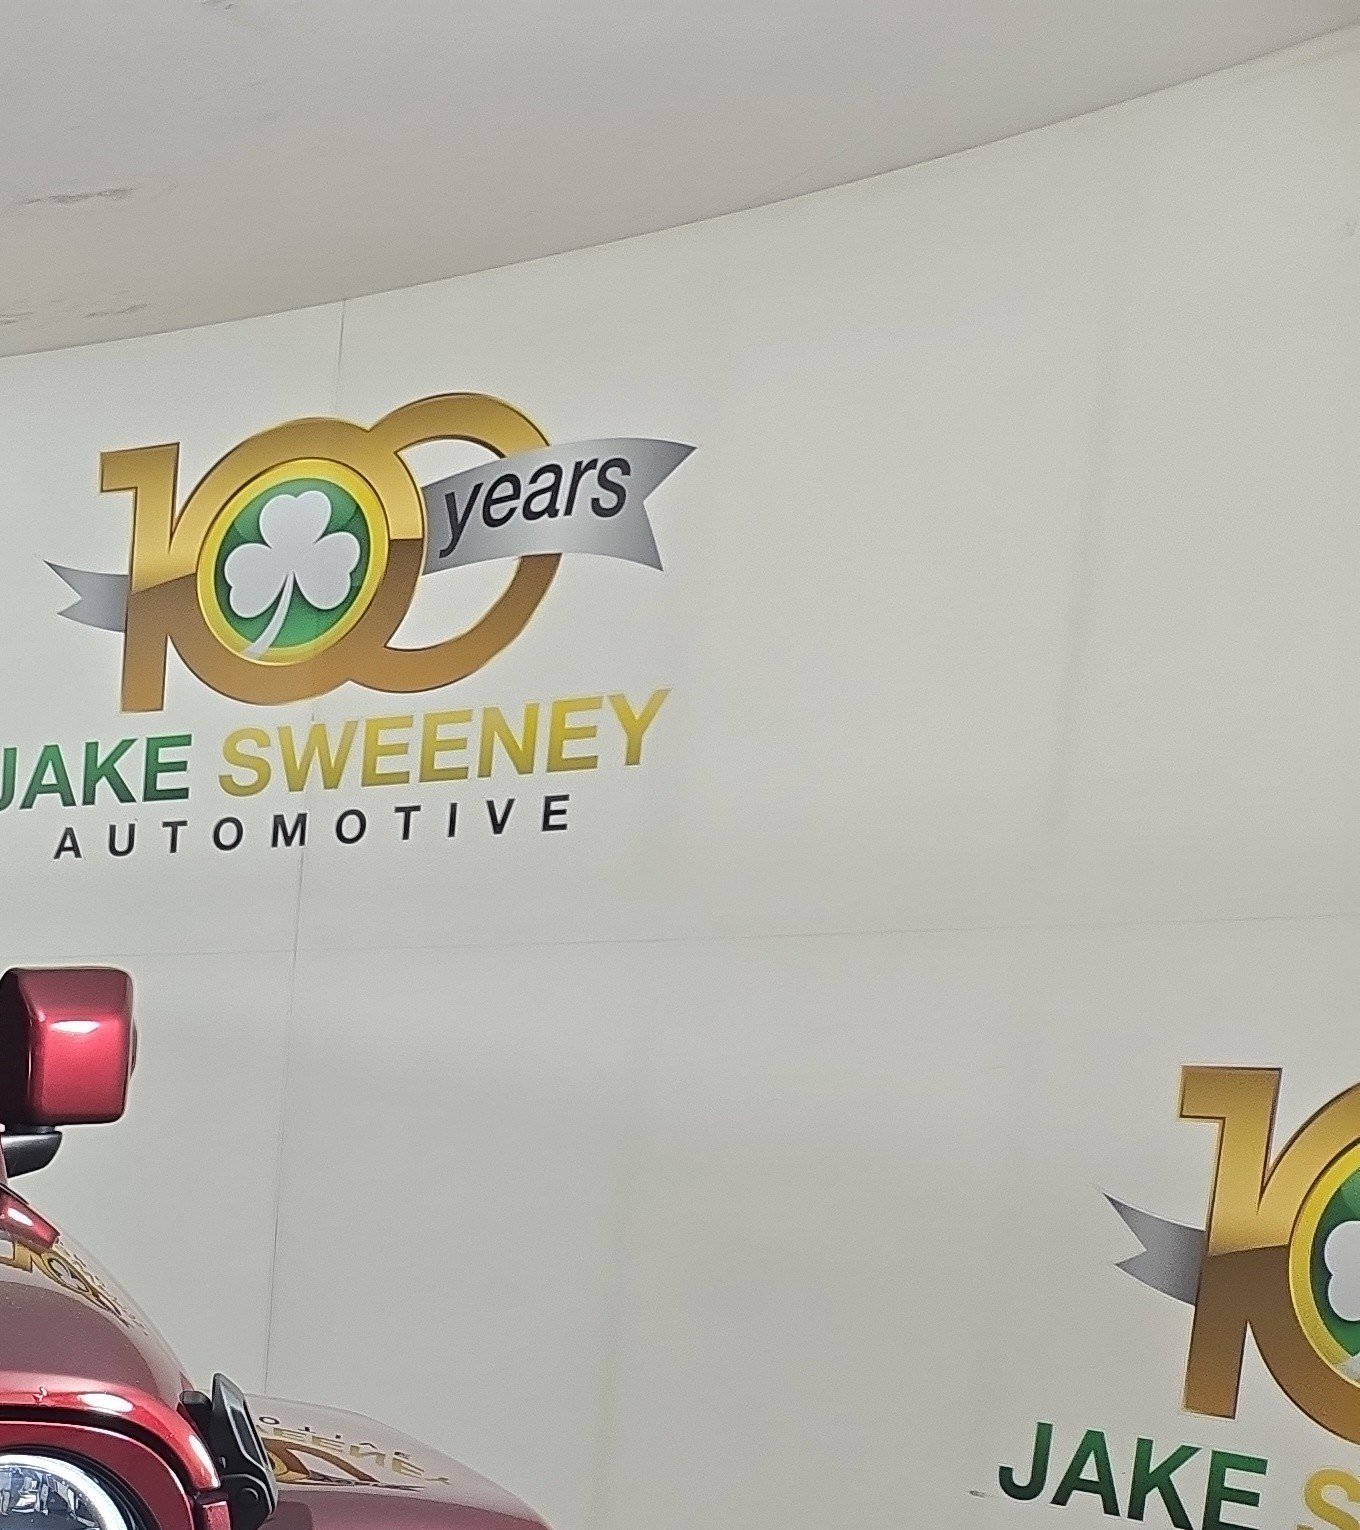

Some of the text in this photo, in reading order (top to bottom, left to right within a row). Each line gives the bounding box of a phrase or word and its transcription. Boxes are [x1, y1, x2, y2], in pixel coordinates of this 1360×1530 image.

[440, 455, 632, 557] years
[218, 688, 672, 797] SWEENEY
[53, 794, 571, 861] AUTOMOTIVE
